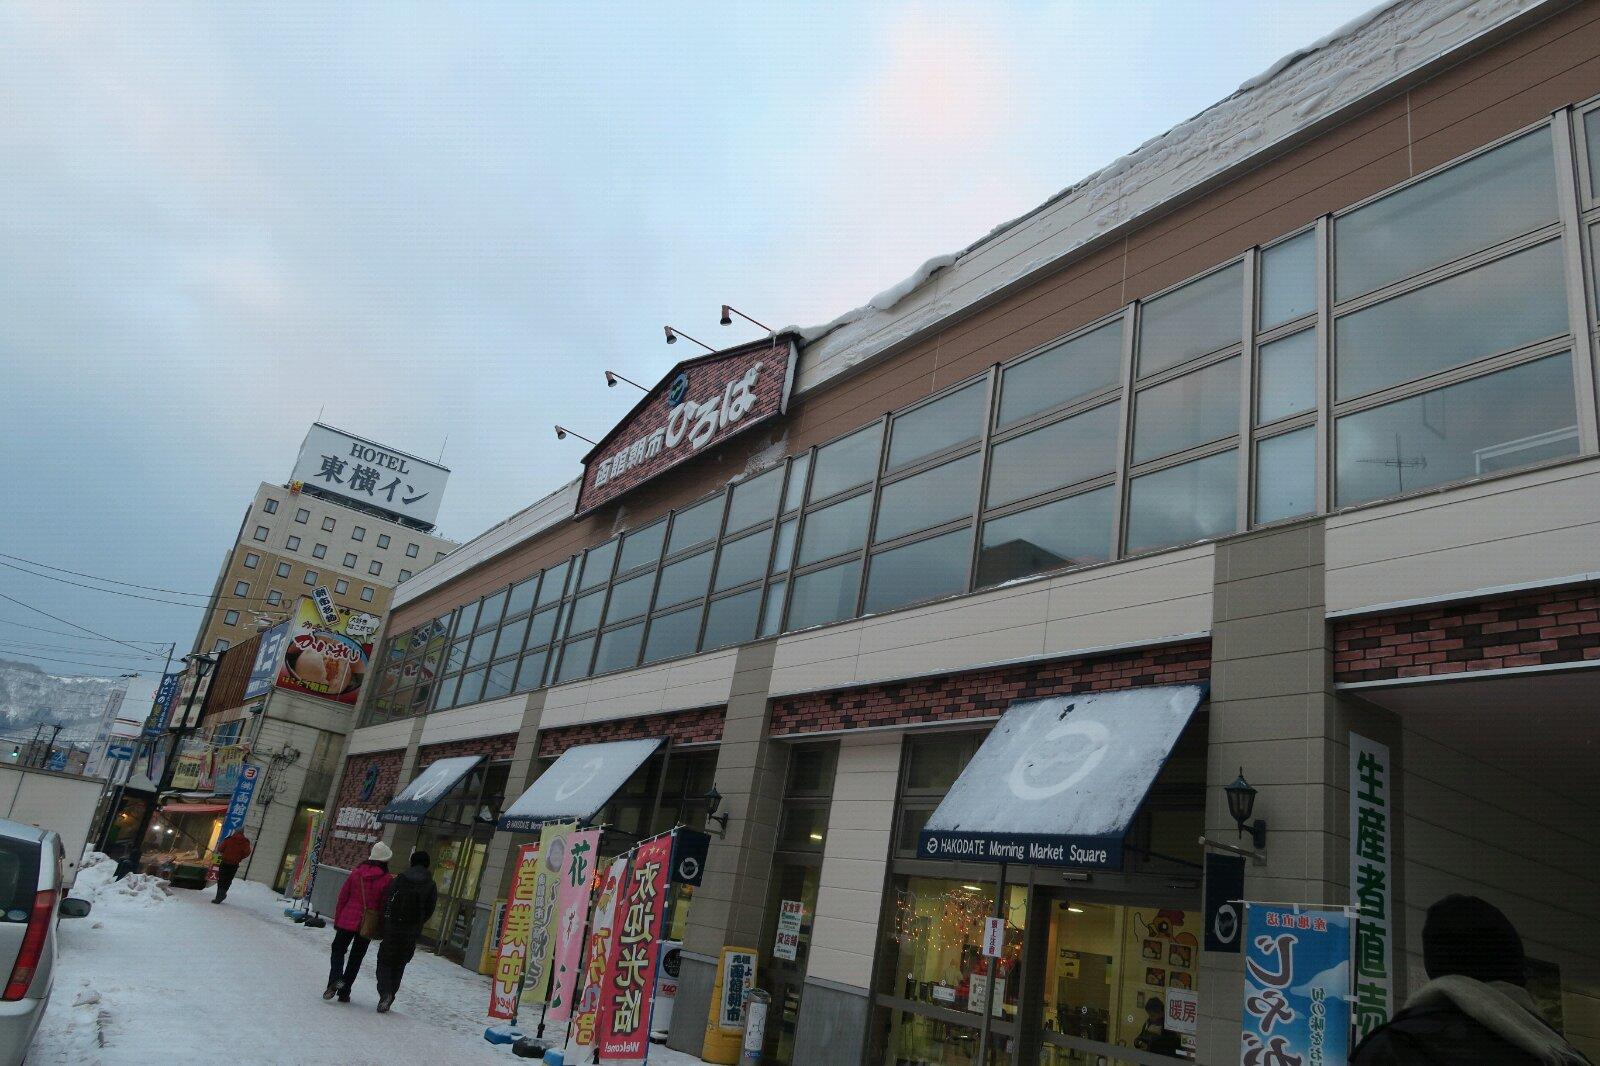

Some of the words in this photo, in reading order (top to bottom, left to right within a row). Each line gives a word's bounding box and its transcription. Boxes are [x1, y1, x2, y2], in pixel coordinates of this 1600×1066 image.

[349, 442, 410, 475] HOTEL
[313, 453, 430, 505] 東横イン
[941, 838, 984, 856] HAKODATE
[989, 841, 1024, 860] Morning
[1029, 843, 1064, 861] Market
[1070, 845, 1107, 864] Square
